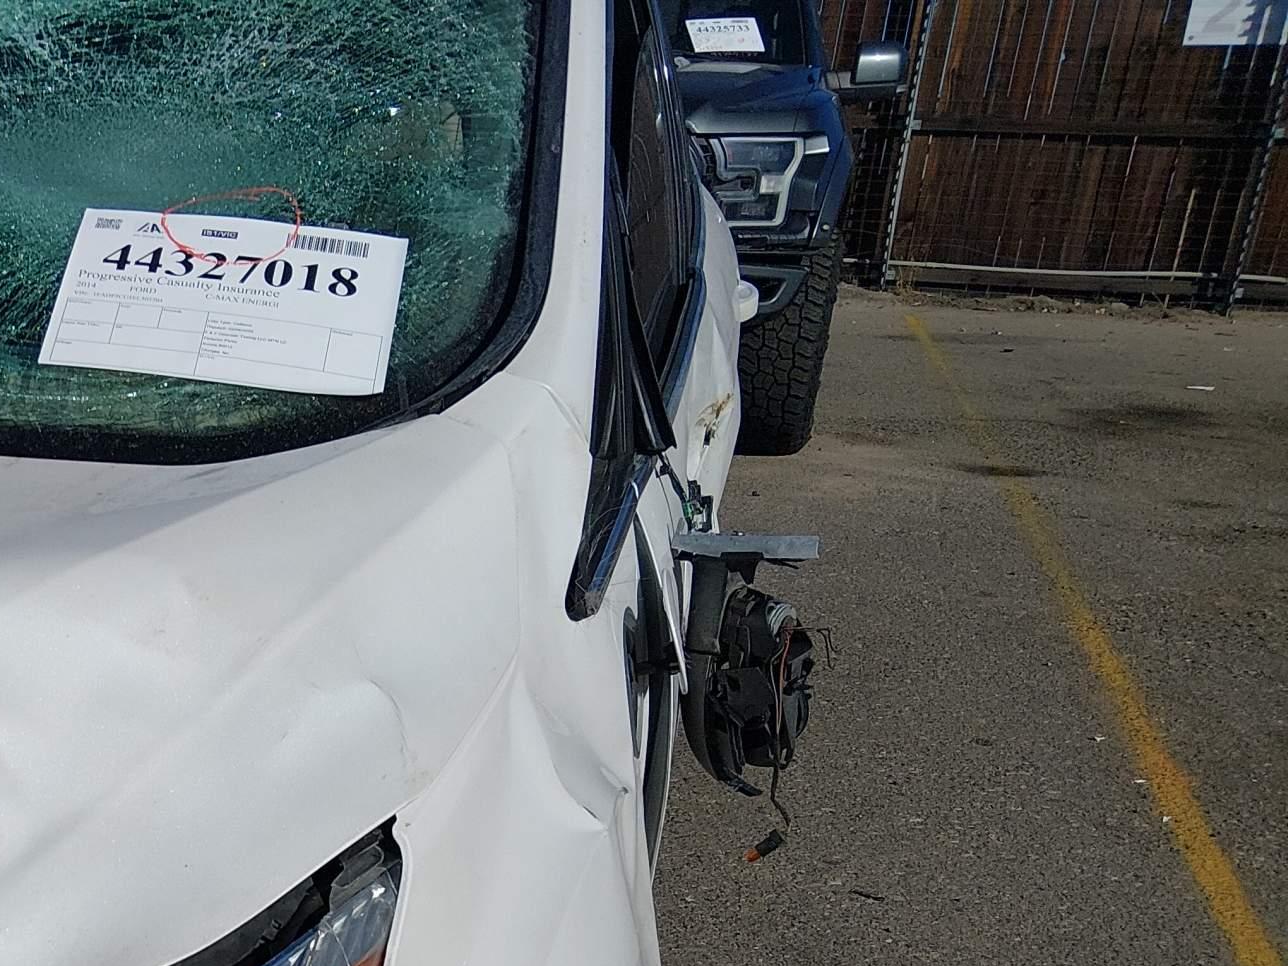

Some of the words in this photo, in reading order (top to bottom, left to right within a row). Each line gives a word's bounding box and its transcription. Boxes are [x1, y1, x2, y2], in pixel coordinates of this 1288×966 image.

[696, 24, 751, 33] 44325733
[78, 269, 152, 284] Progressive
[157, 278, 213, 291] Casualty
[218, 282, 281, 298] Insurance
[103, 244, 359, 297] 44327018
[76, 281, 97, 289] 2014
[129, 286, 157, 295] FORD
[205, 293, 240, 304] C-MAX
[242, 298, 280, 309] ENERGI
